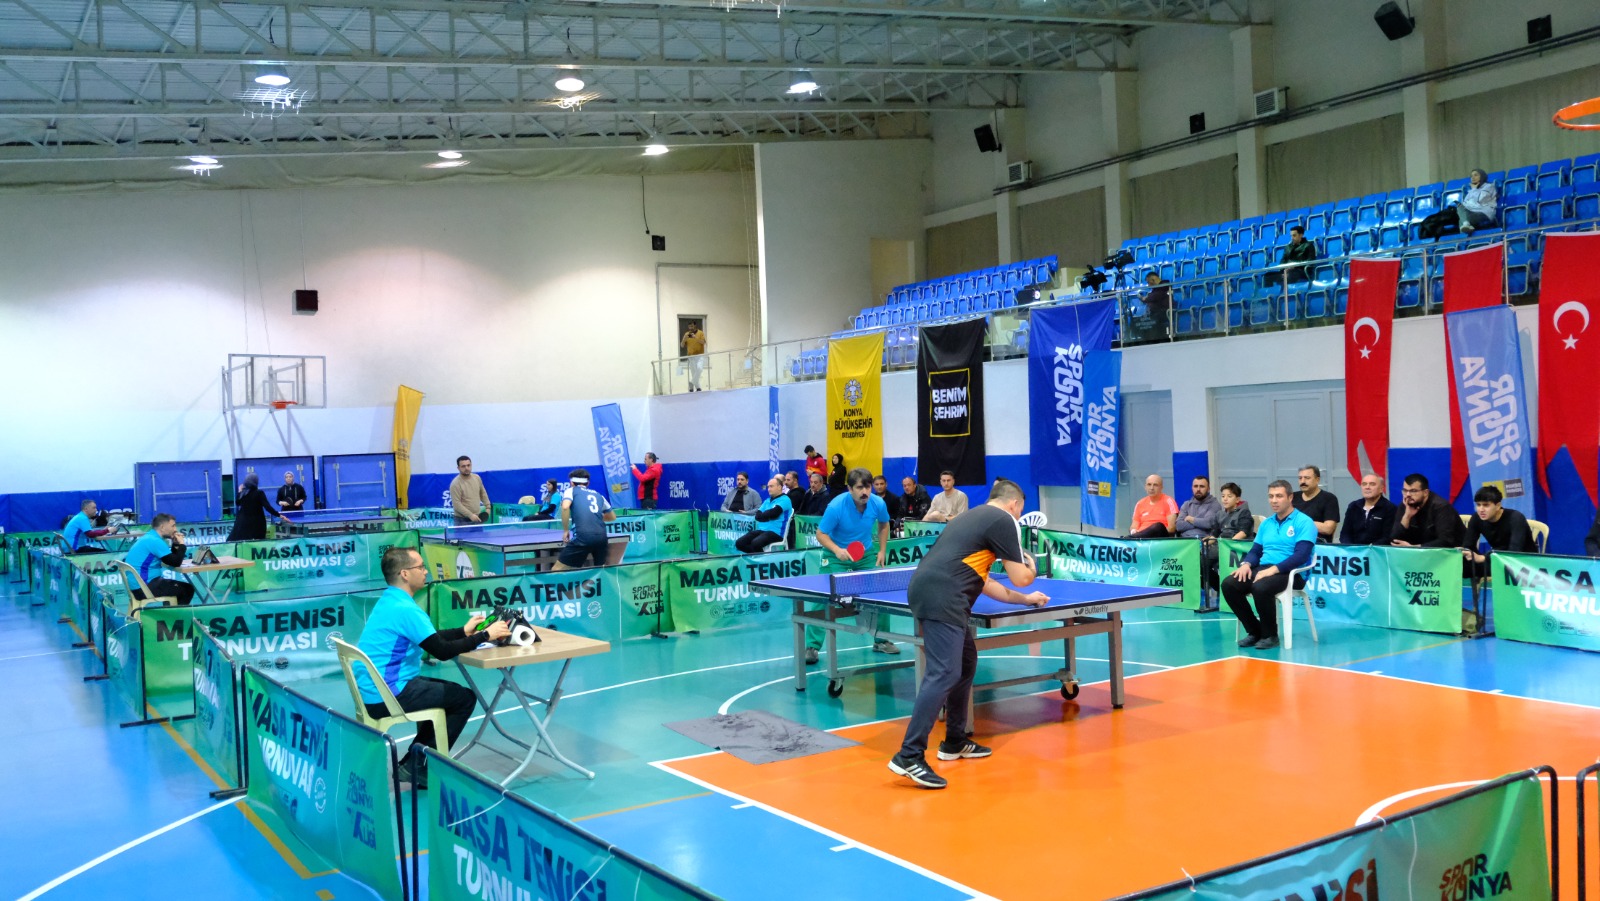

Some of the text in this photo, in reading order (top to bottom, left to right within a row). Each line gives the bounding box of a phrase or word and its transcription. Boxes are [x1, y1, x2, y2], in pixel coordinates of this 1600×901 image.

[1067, 343, 1083, 424] SPOR
[1053, 346, 1074, 446] KONYA
[843, 408, 863, 417] KONYA
[1086, 402, 1101, 471] SPOR
[1096, 386, 1117, 471] KONYA
[669, 481, 685, 490] SPOR
[669, 488, 690, 498] KONYA
[587, 494, 599, 513] 3
[251, 545, 304, 561] MASA
[1043, 539, 1086, 558] MASA
[262, 555, 341, 571] TURNUVASI
[1051, 556, 1124, 578] TURNUVASI
[679, 565, 742, 588] MASA
[1404, 571, 1434, 580] SPOR
[1405, 577, 1441, 588] KONYA
[1503, 563, 1597, 594] MASA
[451, 584, 528, 611] MASA
[632, 584, 656, 594] SPOR
[1084, 604, 1109, 615] Butterfly
[438, 779, 512, 873] MASA
[1439, 853, 1489, 890] SPOR
[1440, 871, 1513, 901] KONYA
